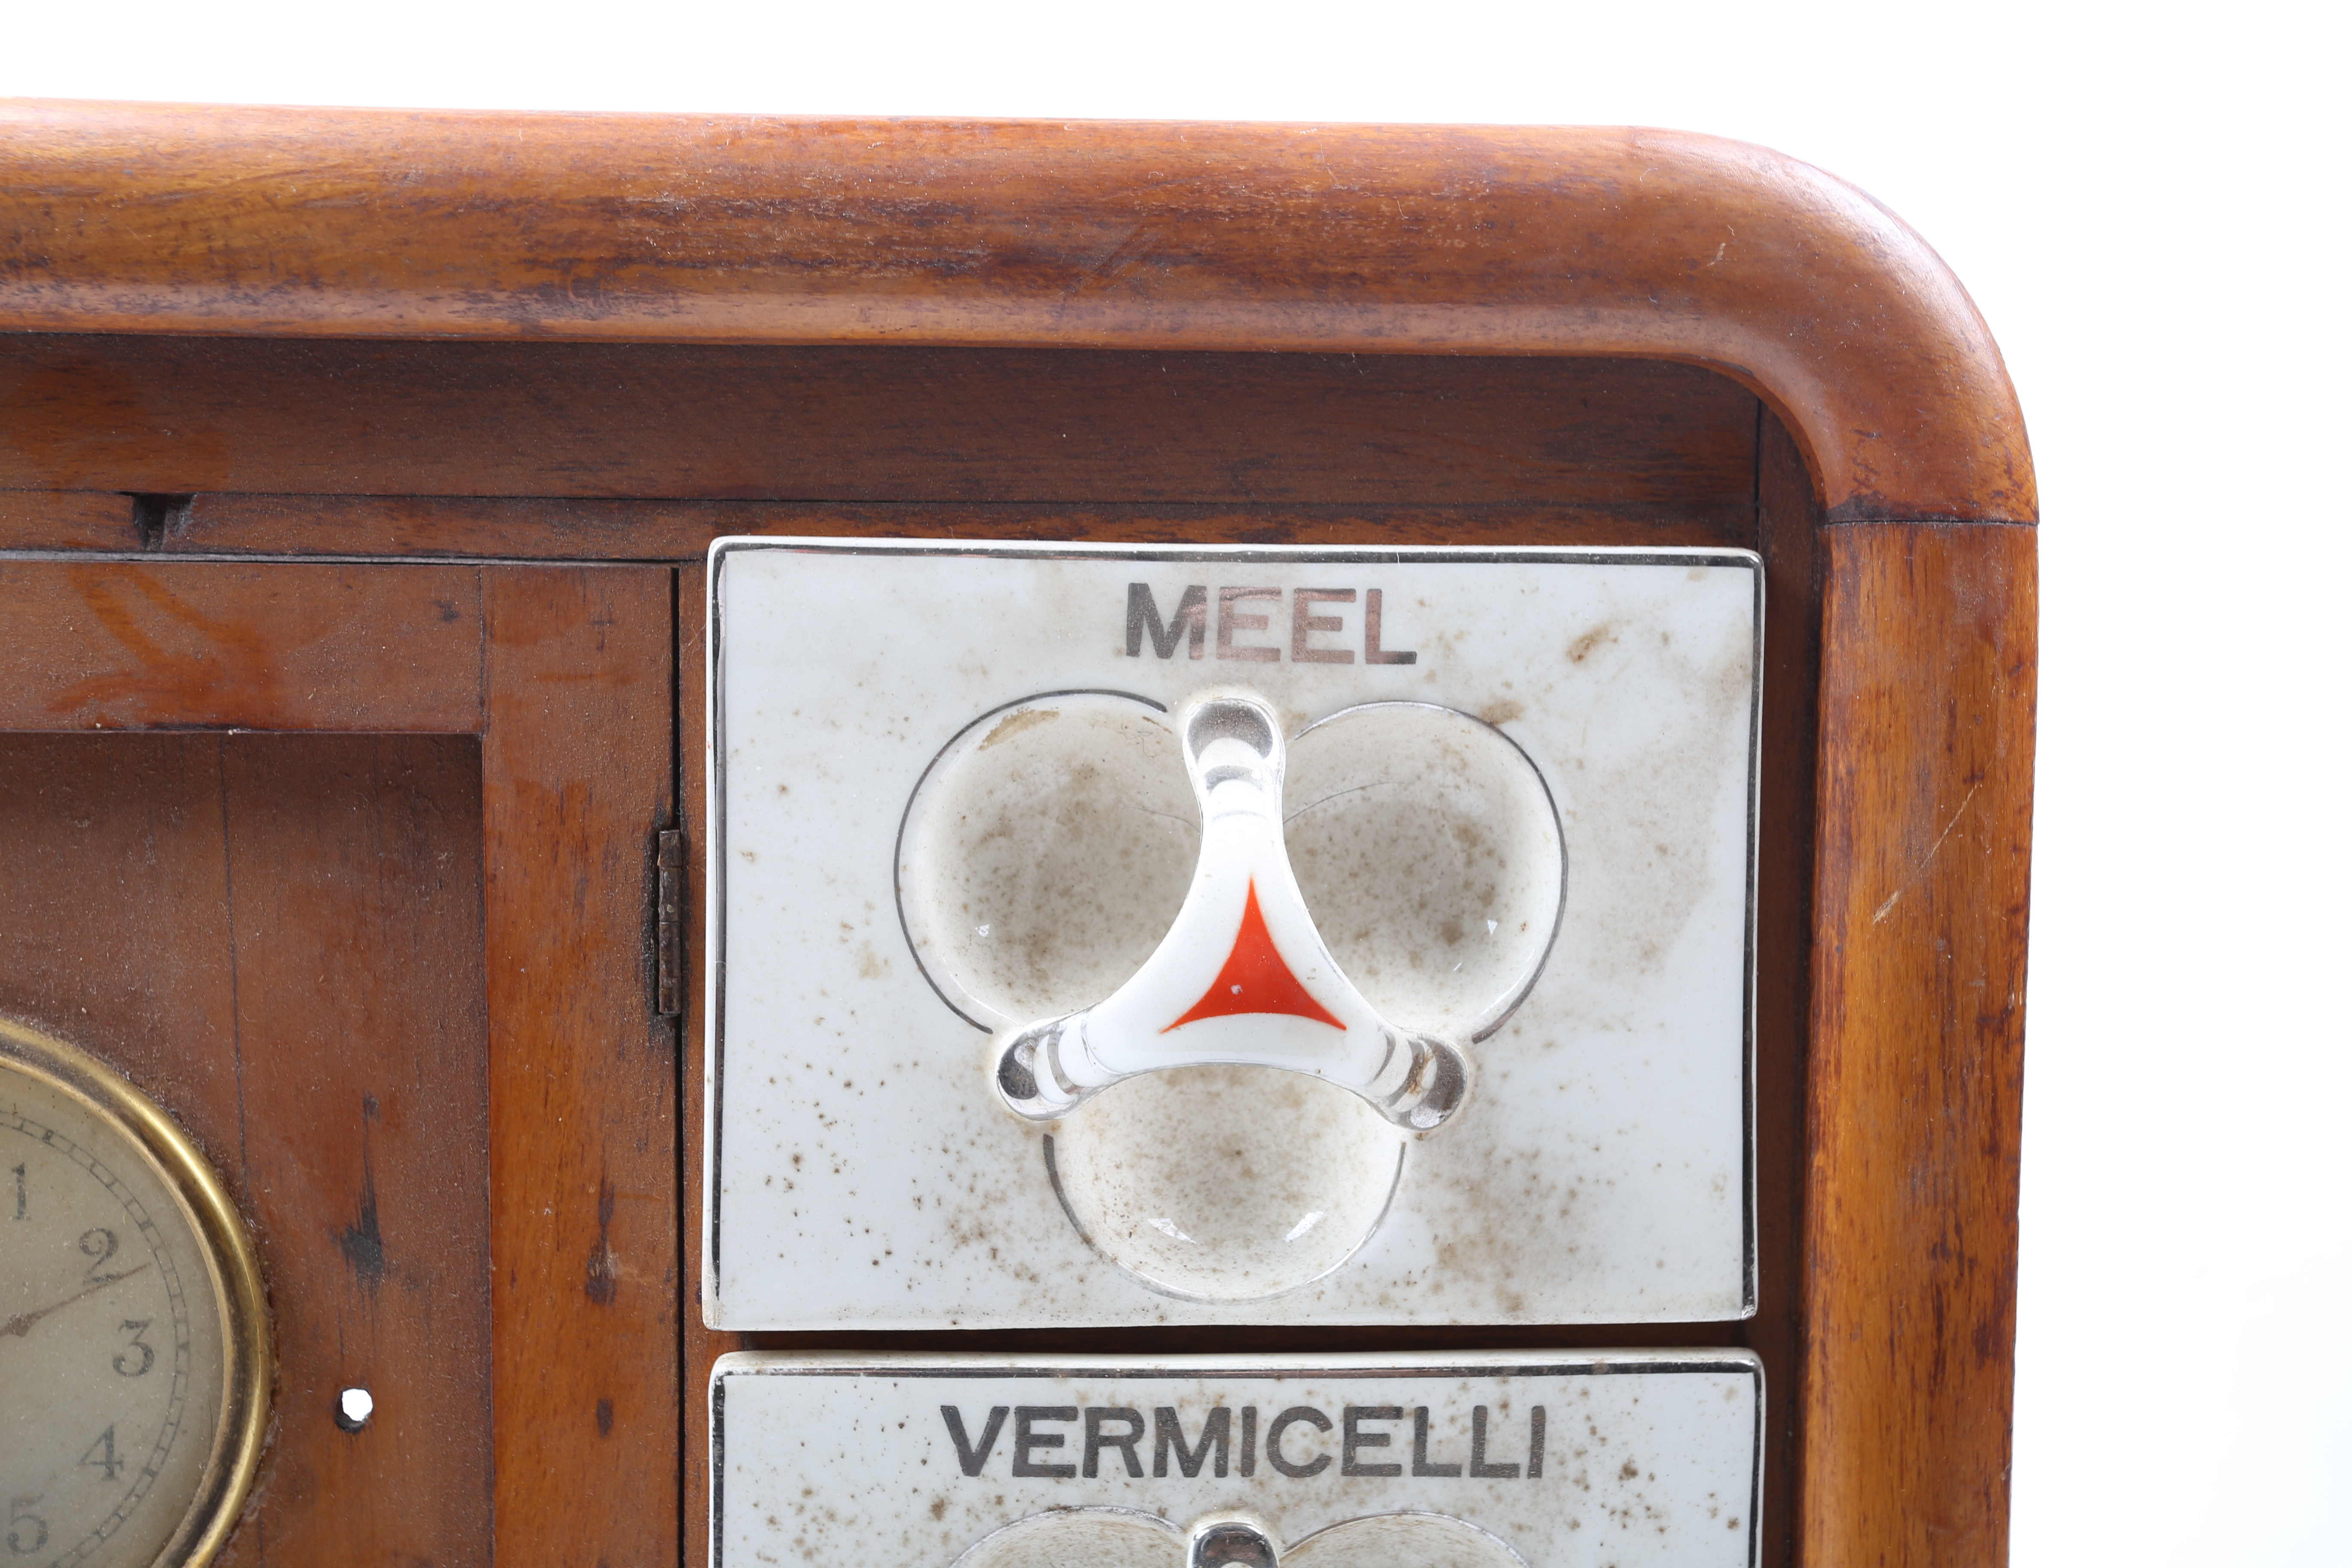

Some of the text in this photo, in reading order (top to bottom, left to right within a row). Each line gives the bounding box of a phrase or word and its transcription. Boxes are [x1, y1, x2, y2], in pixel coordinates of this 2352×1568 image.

[1126, 582, 1417, 665] MEEL
[11, 1162, 31, 1220] 1
[79, 1228, 122, 1286] 2
[112, 1318, 154, 1377] 3
[77, 1424, 124, 1481] 4
[940, 1405, 1546, 1479] VERMICELLI
[7, 1494, 48, 1555] 5
